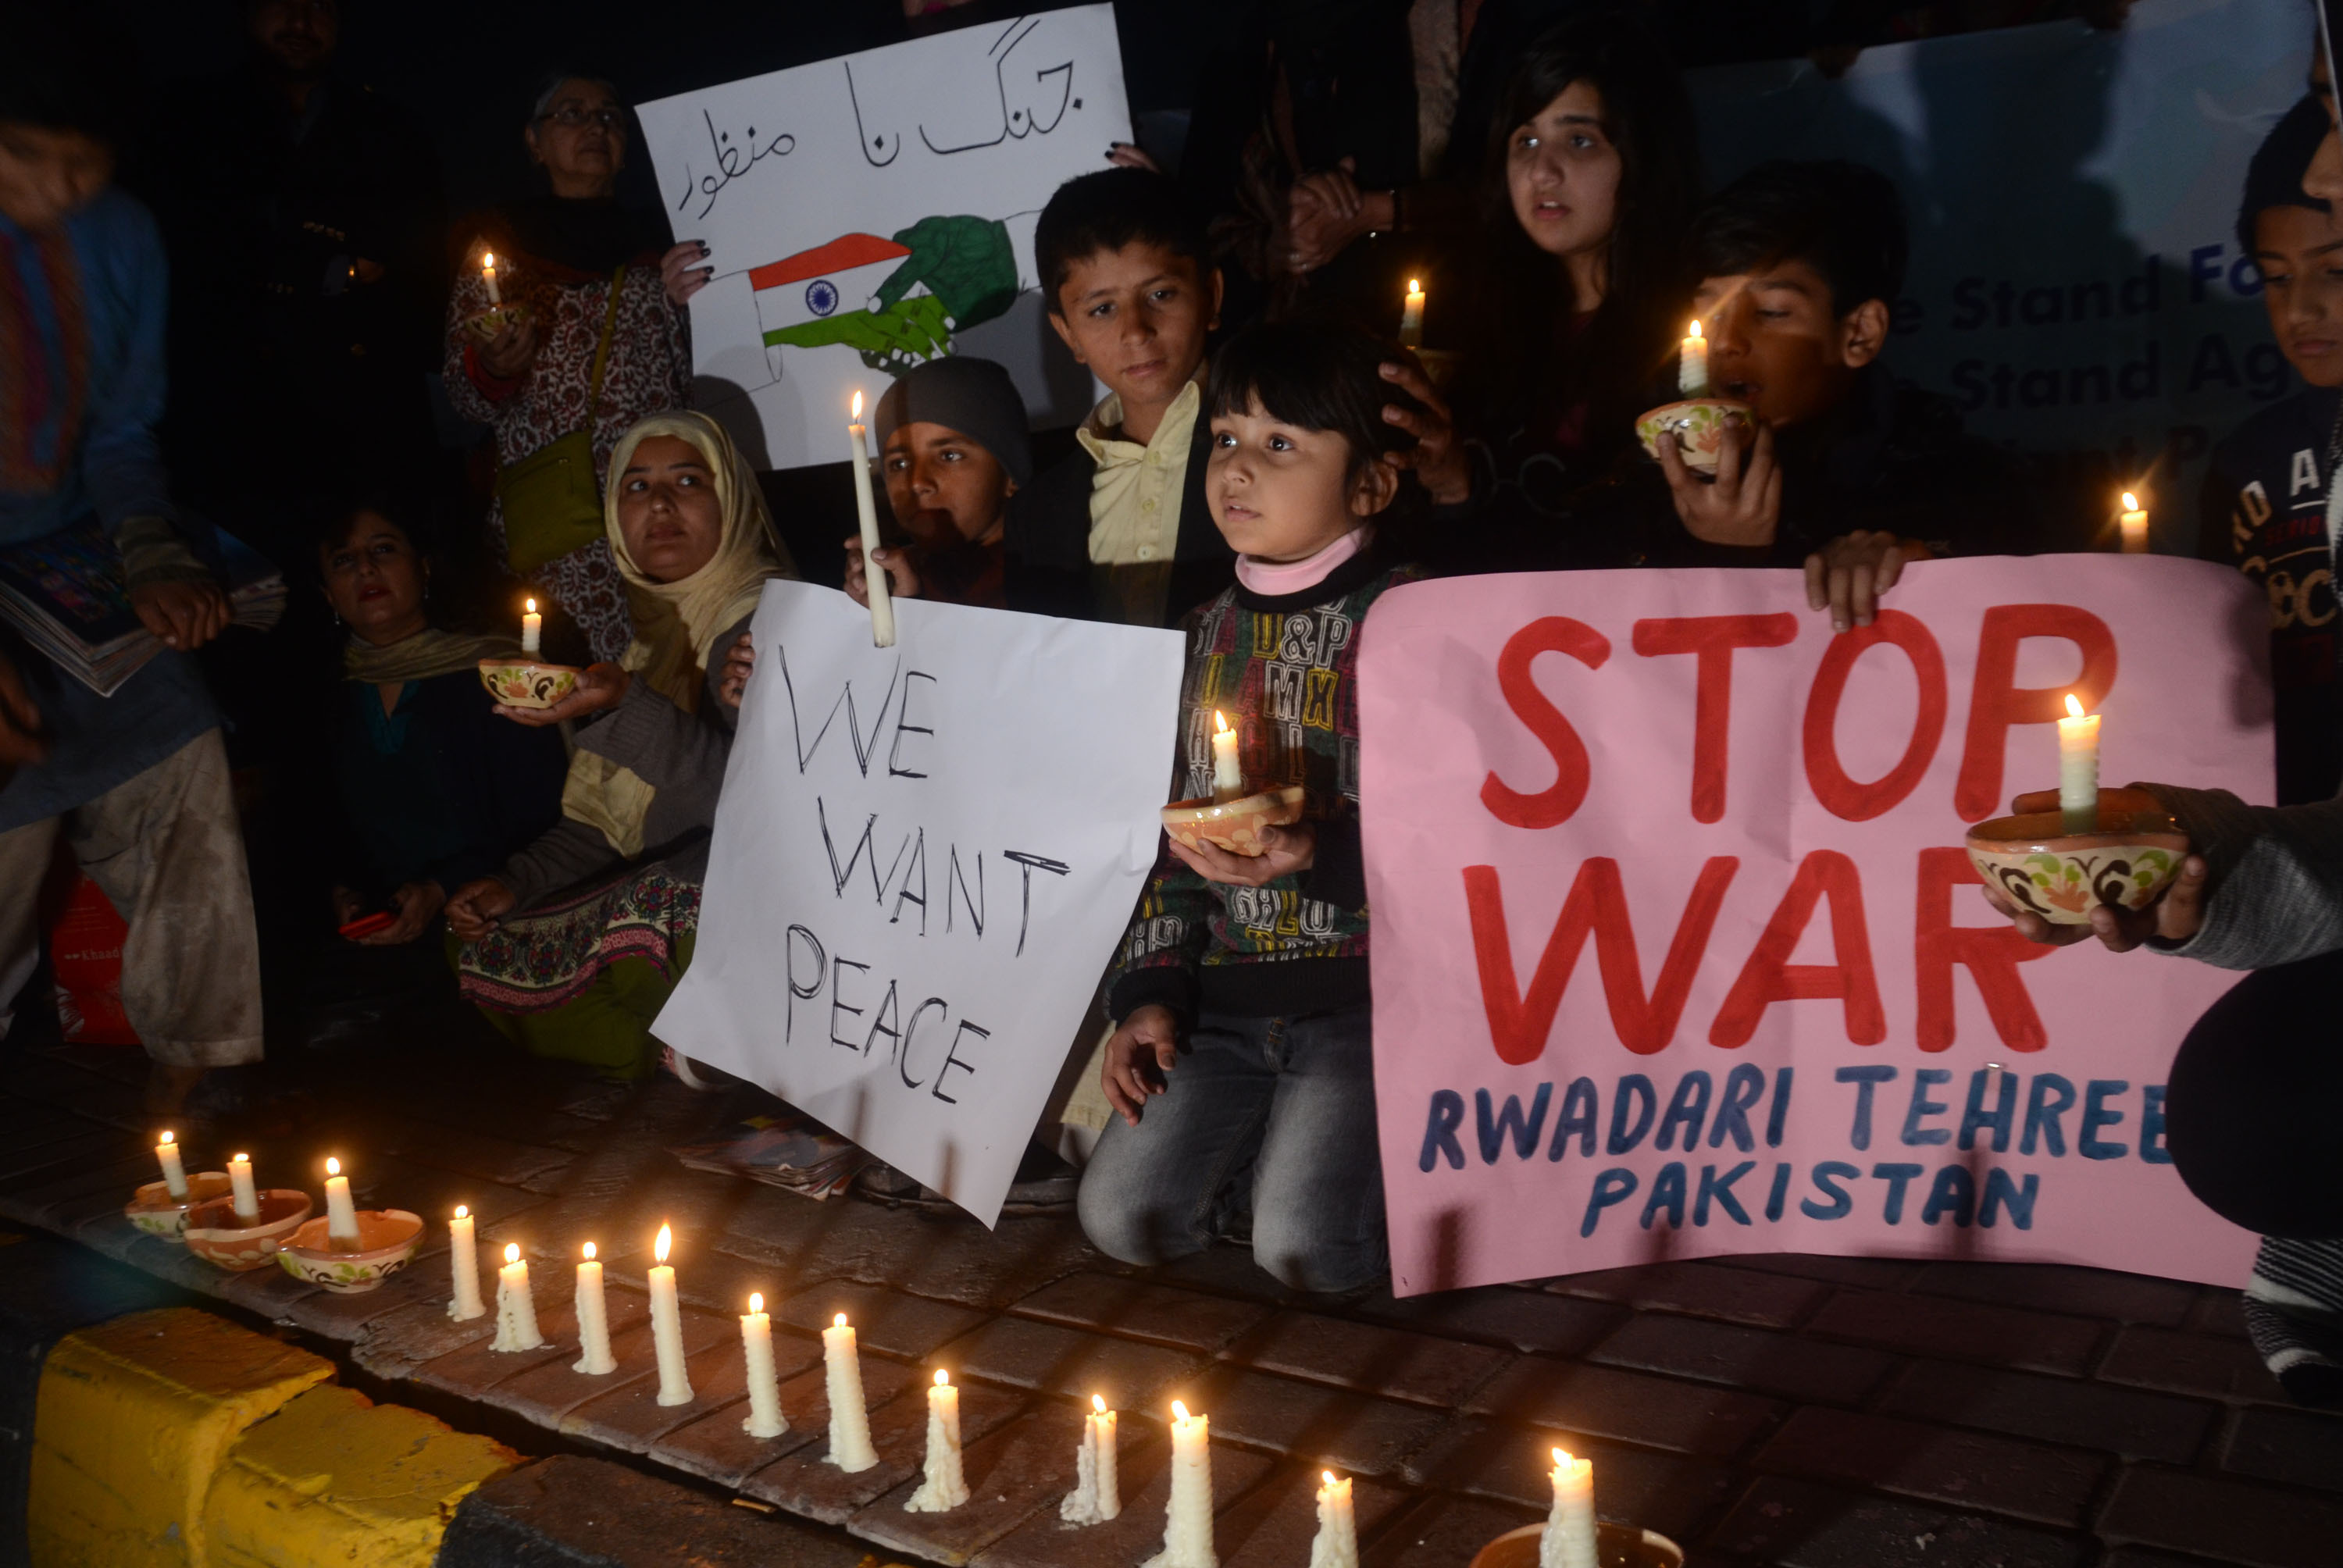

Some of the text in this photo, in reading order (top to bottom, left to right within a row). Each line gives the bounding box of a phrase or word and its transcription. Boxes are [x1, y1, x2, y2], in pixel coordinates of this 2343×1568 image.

[679, 16, 1082, 219] جنگ نا منظور
[1949, 255, 2161, 331] Stand
[1949, 340, 2161, 412] Stand
[779, 645, 938, 779] WE
[1480, 603, 2117, 829] STOP
[818, 796, 1071, 958] WANT
[786, 923, 991, 1105] PEACE
[1462, 847, 2060, 1066] WAR
[1419, 1063, 2175, 1173] RWADARI TEHREE
[1581, 1160, 2040, 1238] PAKISTAN
